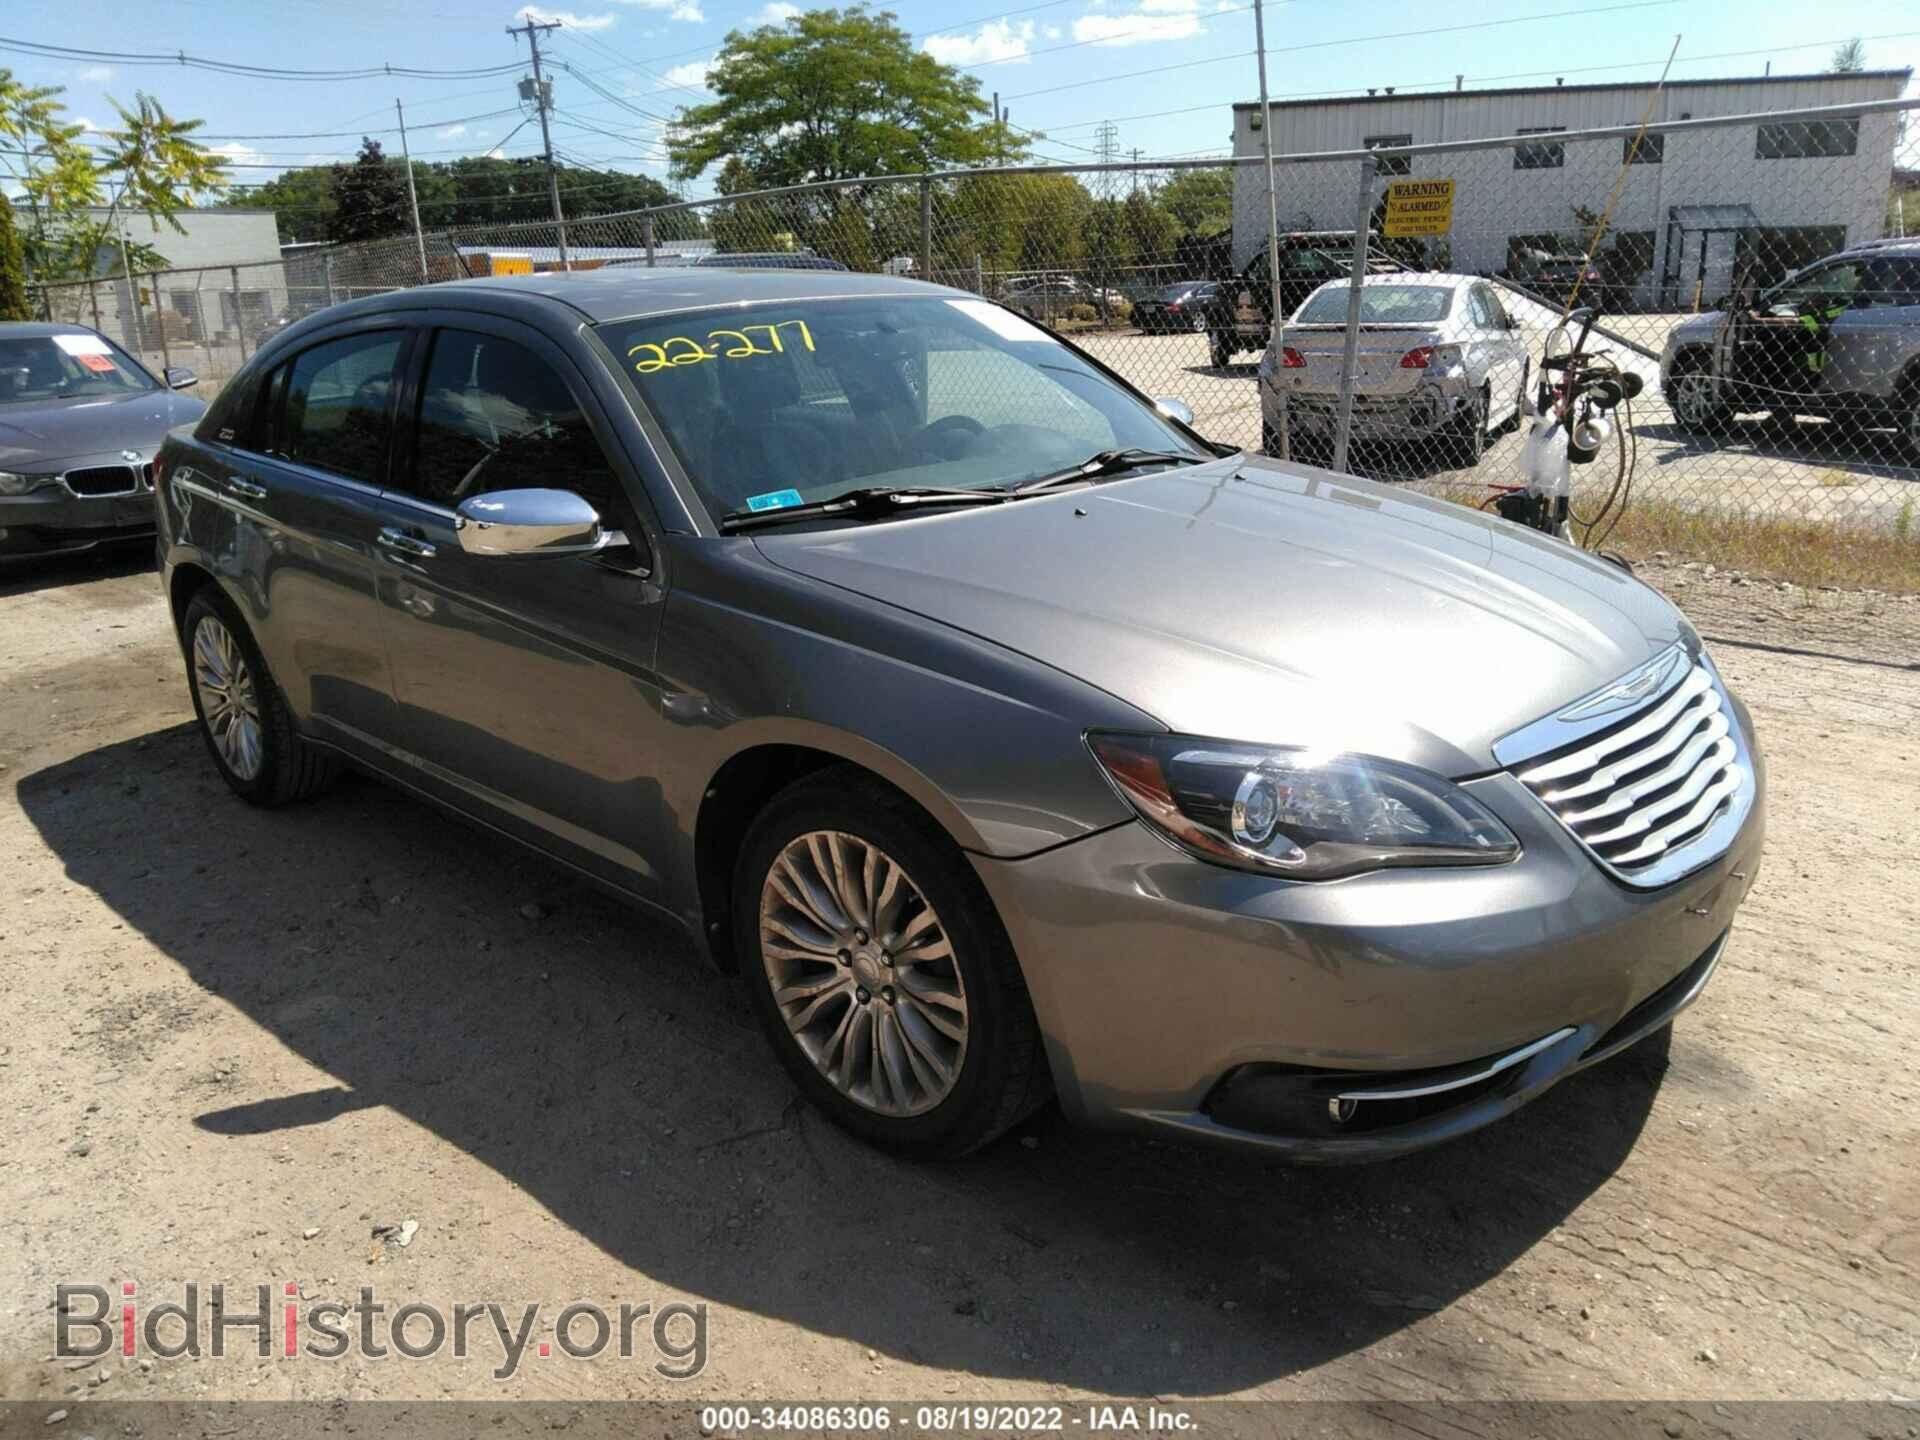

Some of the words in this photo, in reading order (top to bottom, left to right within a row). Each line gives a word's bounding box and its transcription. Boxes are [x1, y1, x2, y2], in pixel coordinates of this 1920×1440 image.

[1393, 182, 1450, 197] WARNING
[1398, 200, 1441, 212] ALARMED
[627, 320, 816, 373] 22-277
